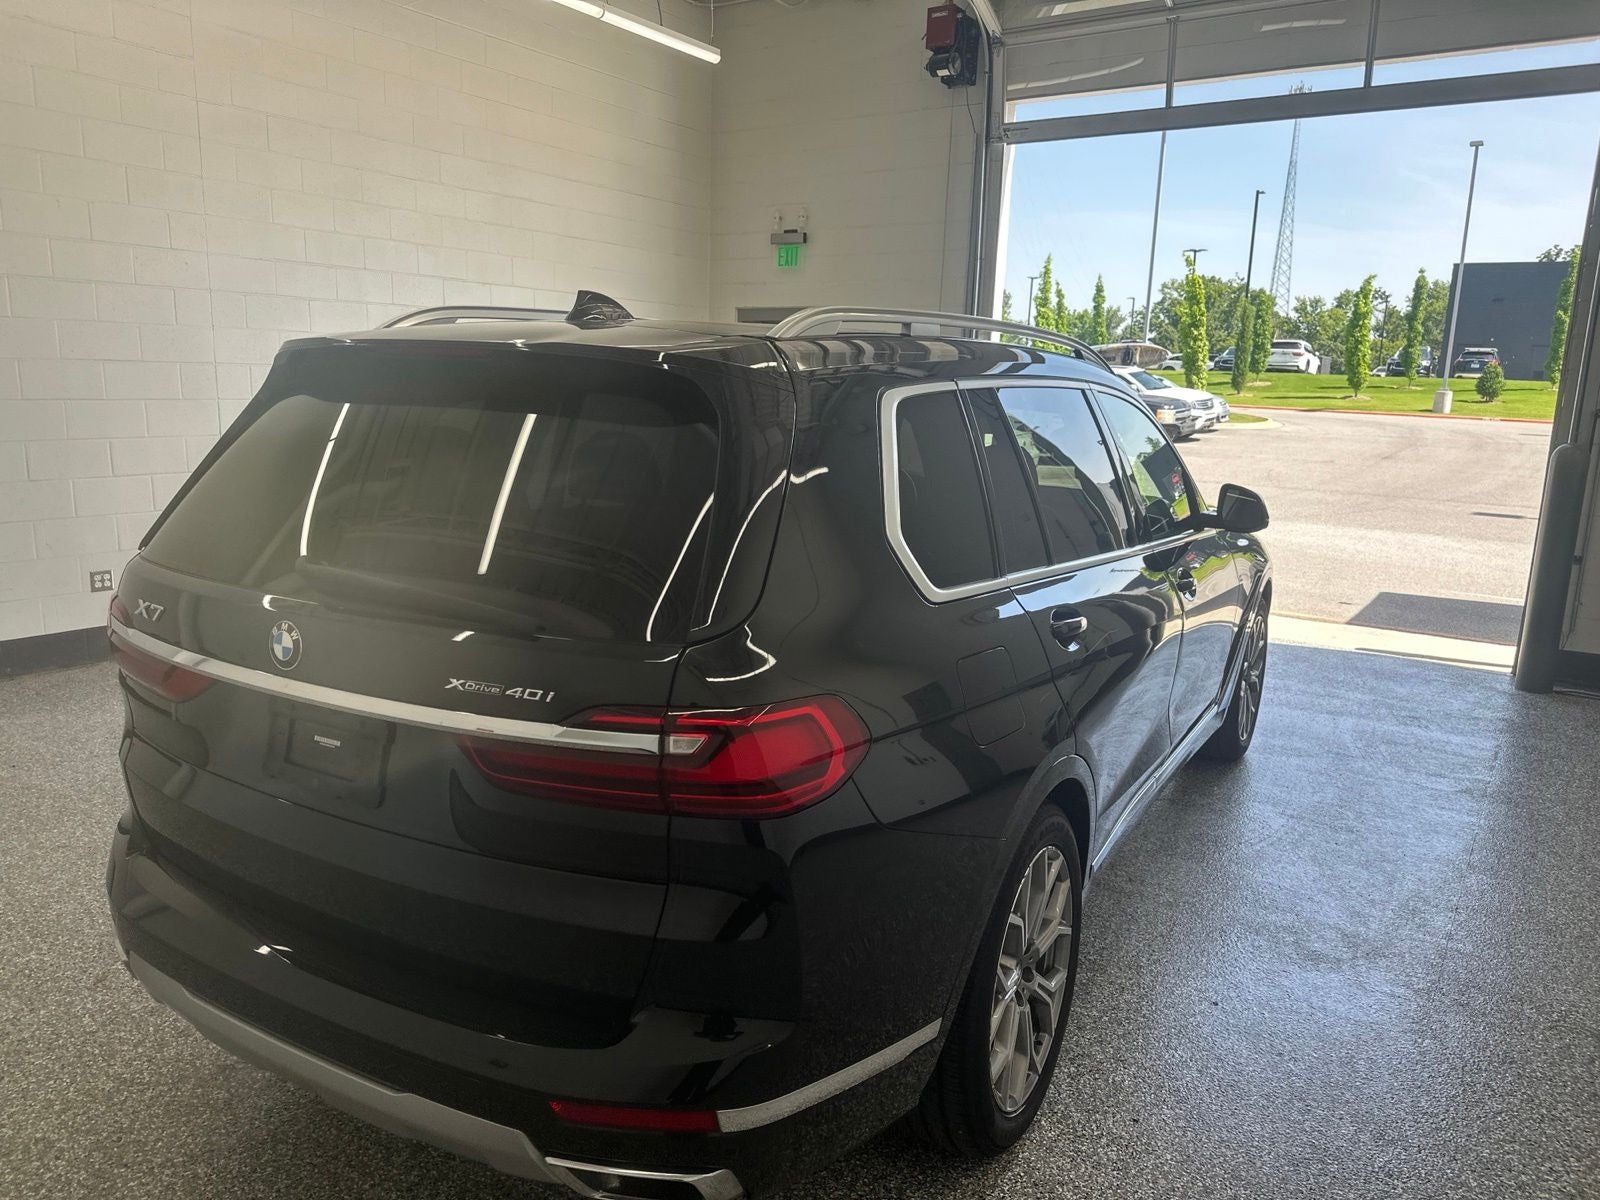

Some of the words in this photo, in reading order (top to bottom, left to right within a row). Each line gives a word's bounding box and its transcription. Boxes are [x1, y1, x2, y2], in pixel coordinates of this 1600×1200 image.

[778, 247, 800, 267] EXIT
[134, 599, 164, 621] X7
[272, 622, 299, 640] BMW
